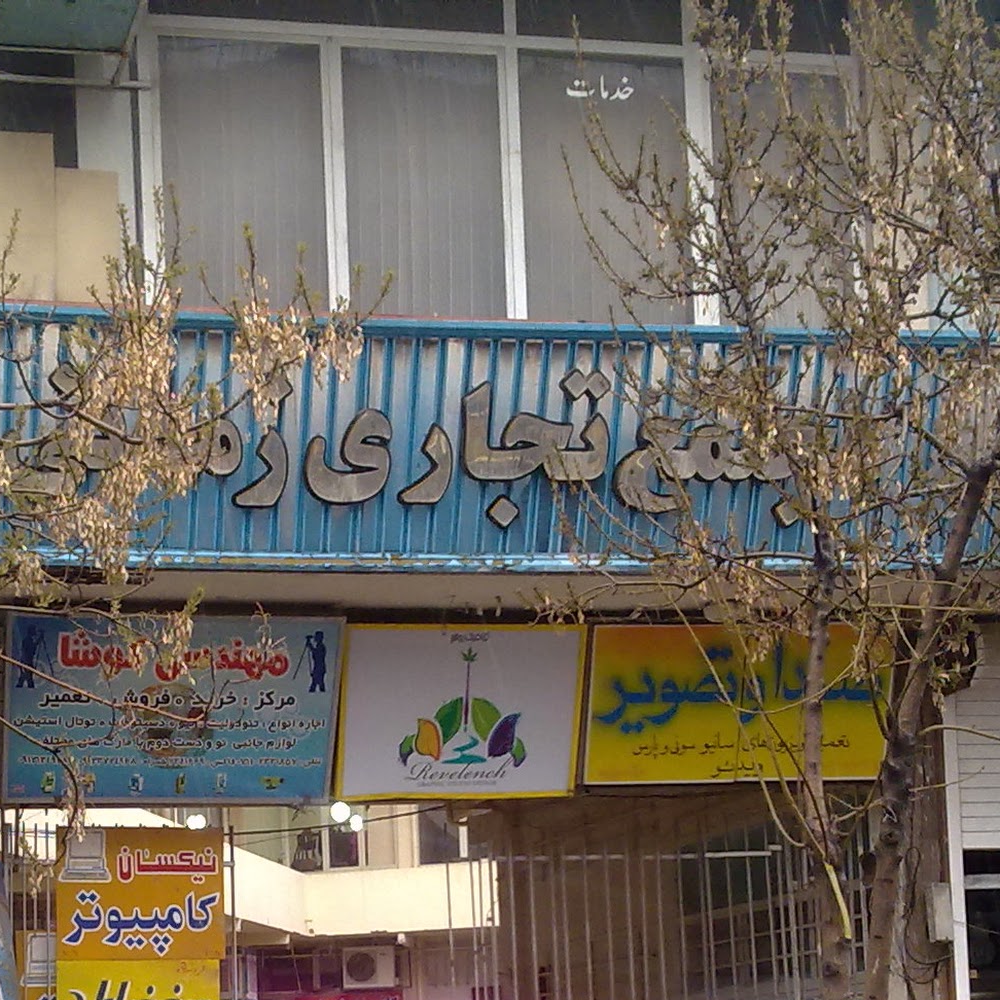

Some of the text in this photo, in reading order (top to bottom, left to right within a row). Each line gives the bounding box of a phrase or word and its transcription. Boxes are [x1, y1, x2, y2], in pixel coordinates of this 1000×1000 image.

[566, 75, 634, 100] خدمات
[304, 366, 611, 530] تجاری
[253, 689, 297, 711] مرکز
[592, 647, 738, 735] تصویر
[117, 846, 218, 883] نیکسان
[61, 889, 221, 957] کامپیوتر
